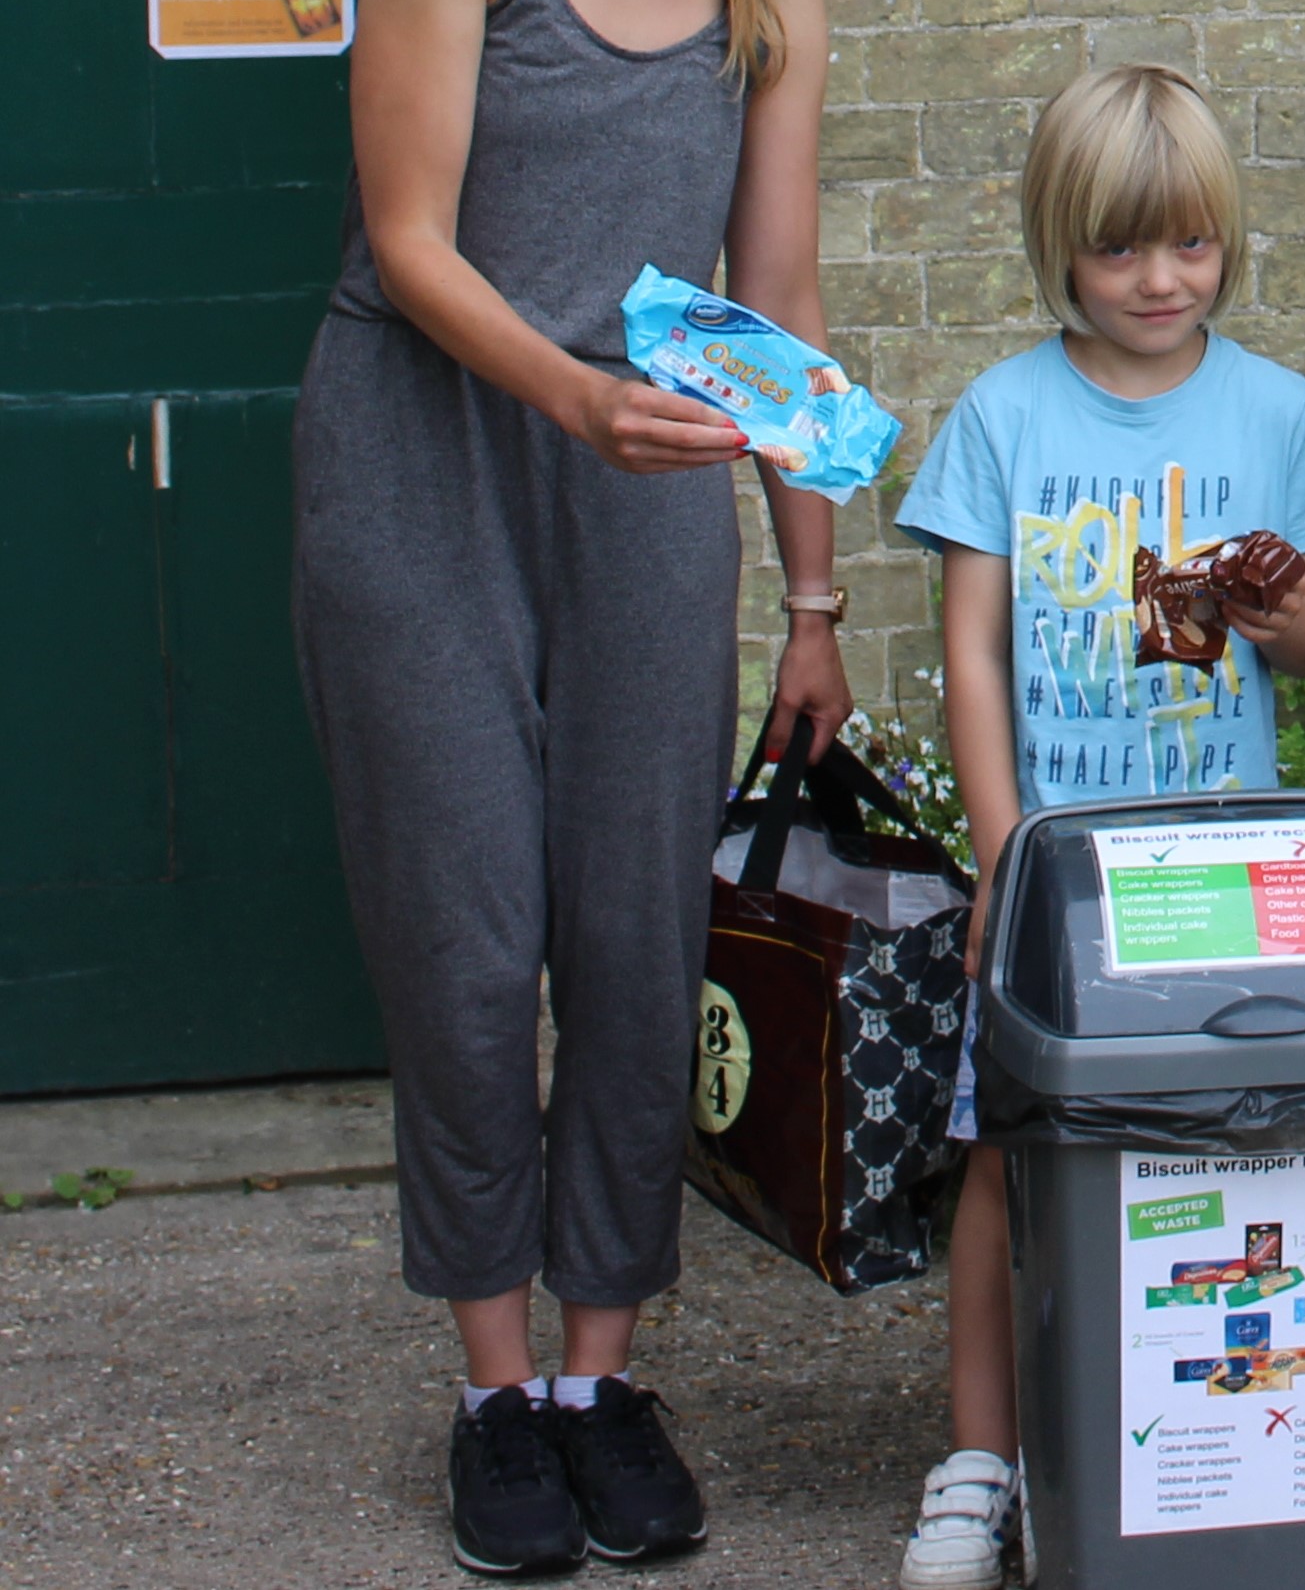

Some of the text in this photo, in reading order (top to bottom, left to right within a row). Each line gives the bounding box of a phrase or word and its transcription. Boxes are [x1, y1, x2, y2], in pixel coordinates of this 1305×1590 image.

[703, 342, 793, 405] Oaties
[1110, 832, 1180, 845] Biscuit
[1186, 828, 1266, 841] wrapper
[1116, 866, 1209, 878] Biscuit wrappers
[1118, 879, 1203, 890] Cake wrappers
[1263, 873, 1288, 884] Dirty
[1120, 891, 1220, 903] Cracker wrappers
[1265, 887, 1295, 896] Cake
[1122, 905, 1211, 916] Nibbles packets
[1267, 900, 1297, 909] Other
[1269, 913, 1305, 923] Plastic
[1124, 921, 1208, 932] Individual cake
[1125, 934, 1178, 945] wrappers
[1271, 928, 1300, 939] Food
[1137, 1159, 1208, 1178] Biscuit
[1213, 1156, 1296, 1175] wrapper
[1139, 1199, 1208, 1220] ACCEPTED
[1152, 1215, 1200, 1231] WASTE
[1132, 1334, 1142, 1348] 2
[1158, 1424, 1236, 1437] Biscuit wrappers
[1158, 1441, 1229, 1453] Cake wrappers
[1158, 1457, 1242, 1469] Cracker wrappers
[1158, 1473, 1233, 1485] Nibbles packets
[1158, 1489, 1228, 1501] Individual cake
[1158, 1503, 1201, 1514] wrappers
